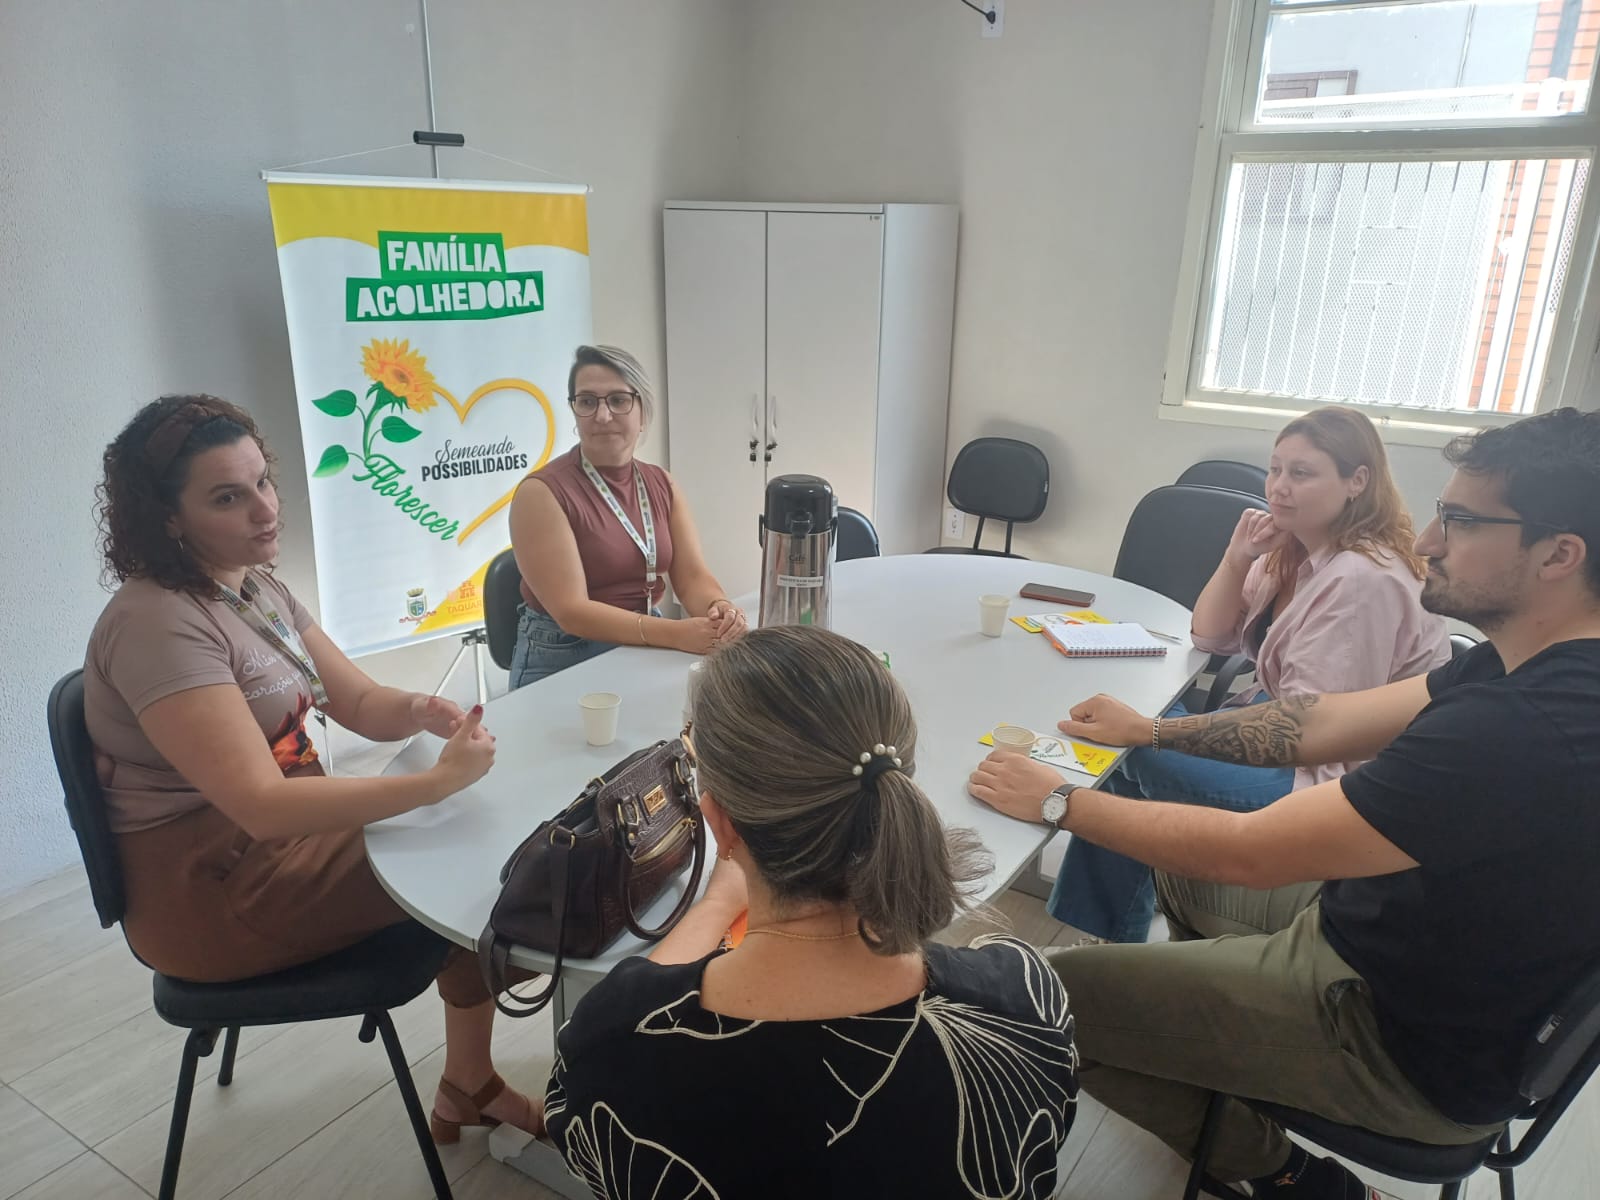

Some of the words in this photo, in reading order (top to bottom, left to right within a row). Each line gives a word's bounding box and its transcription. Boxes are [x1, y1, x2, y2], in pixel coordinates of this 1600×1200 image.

[386, 234, 502, 273] FAMÍLIA
[356, 278, 542, 318] ACOLHEDORA
[434, 434, 515, 464] Semeando
[421, 453, 528, 482] POSSIBILIDADES
[352, 453, 460, 541] Florescer
[446, 599, 483, 615] TAQUAR
